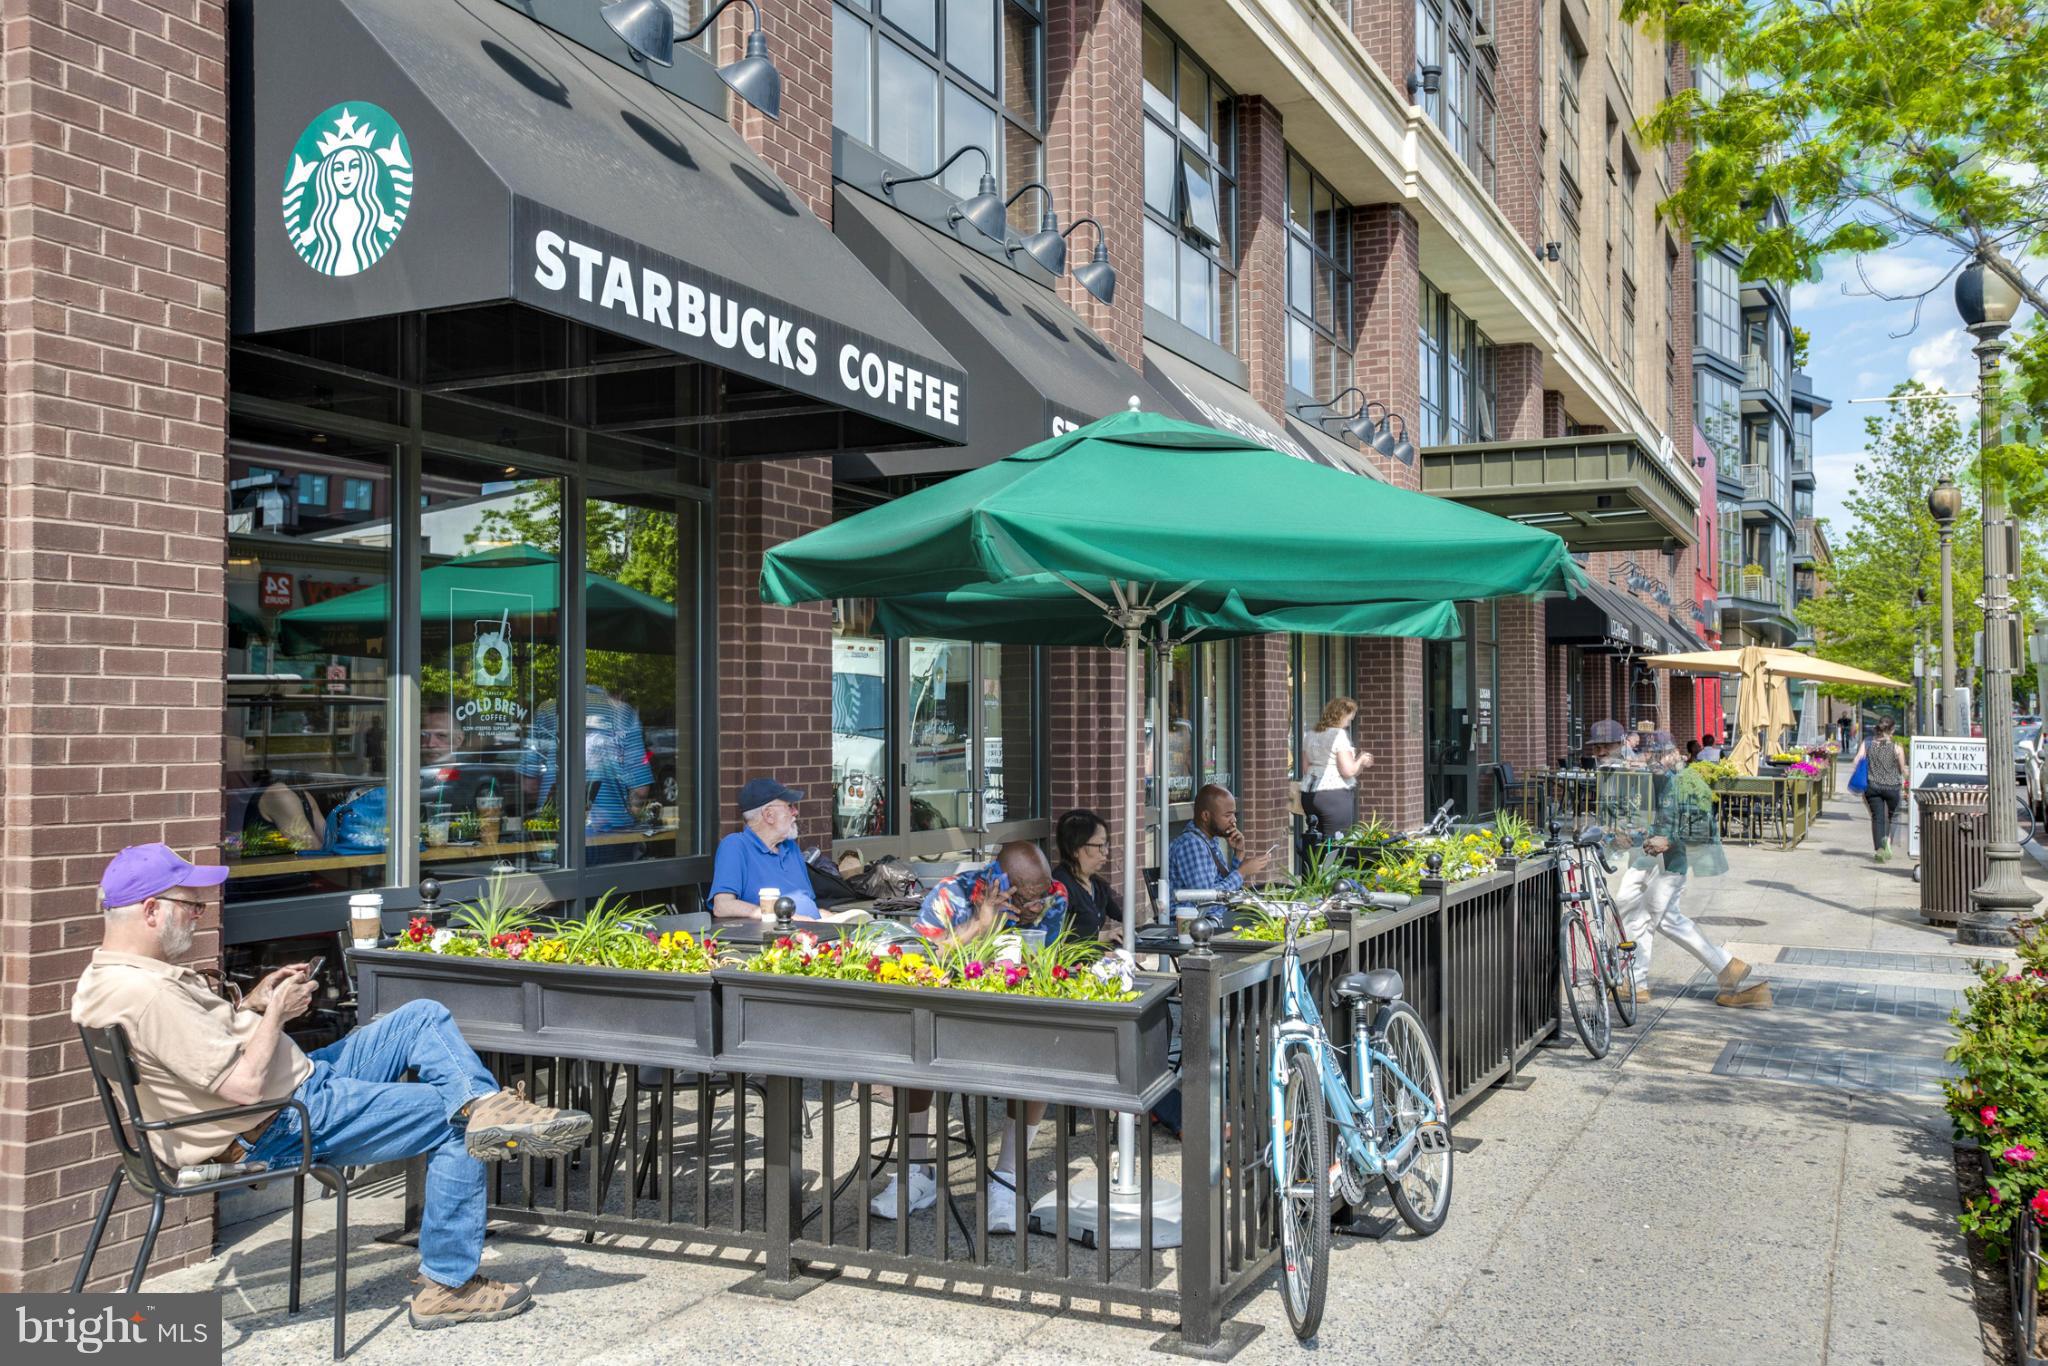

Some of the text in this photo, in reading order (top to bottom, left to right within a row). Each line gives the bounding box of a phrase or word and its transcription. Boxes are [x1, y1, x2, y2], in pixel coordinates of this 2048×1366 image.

[534, 230, 960, 426] STARBUCKS COFFEE
[456, 697, 528, 721] COLD BREW
[480, 713, 507, 721] COFFEE
[1916, 743, 1949, 751] HUDSON
[1931, 752, 1977, 761] LUXURY
